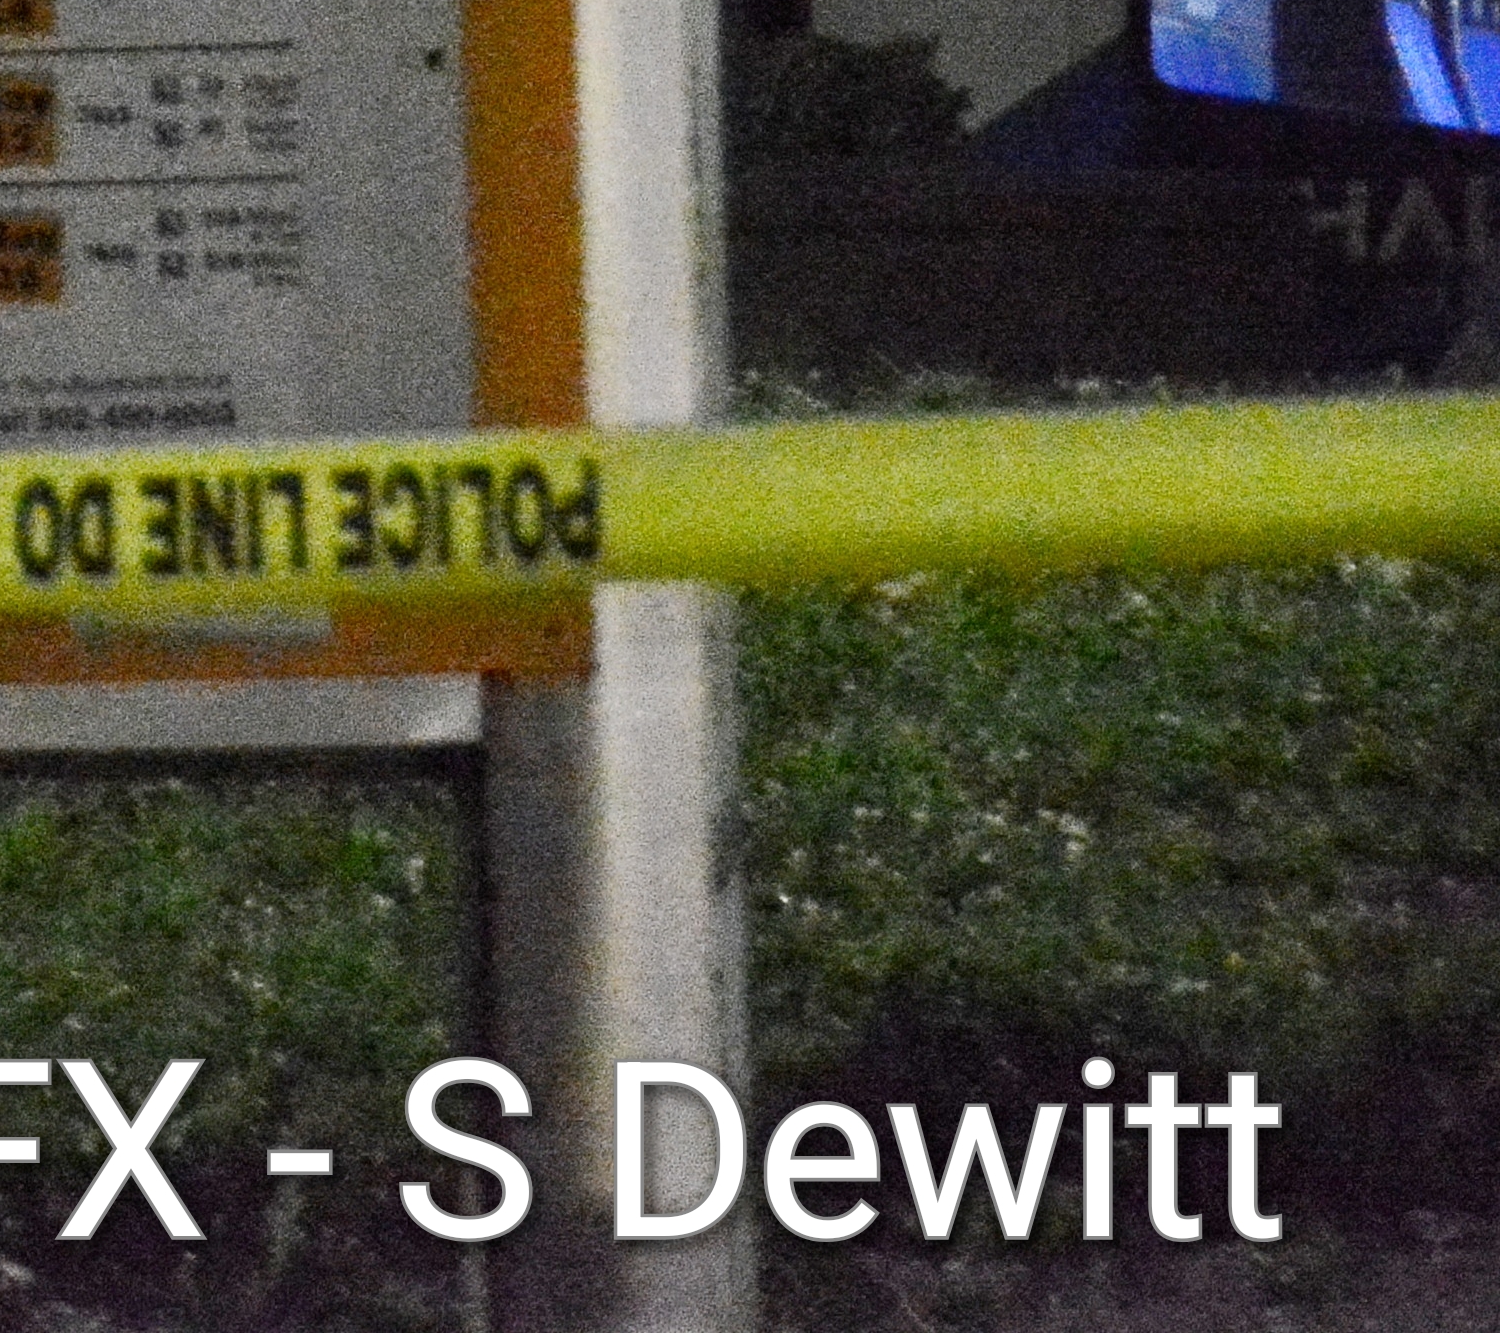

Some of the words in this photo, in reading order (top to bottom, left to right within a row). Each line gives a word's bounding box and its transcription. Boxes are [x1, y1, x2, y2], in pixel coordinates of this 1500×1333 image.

[15, 474, 116, 583] DO
[139, 469, 310, 579] LINE
[330, 455, 603, 571] POLICE
